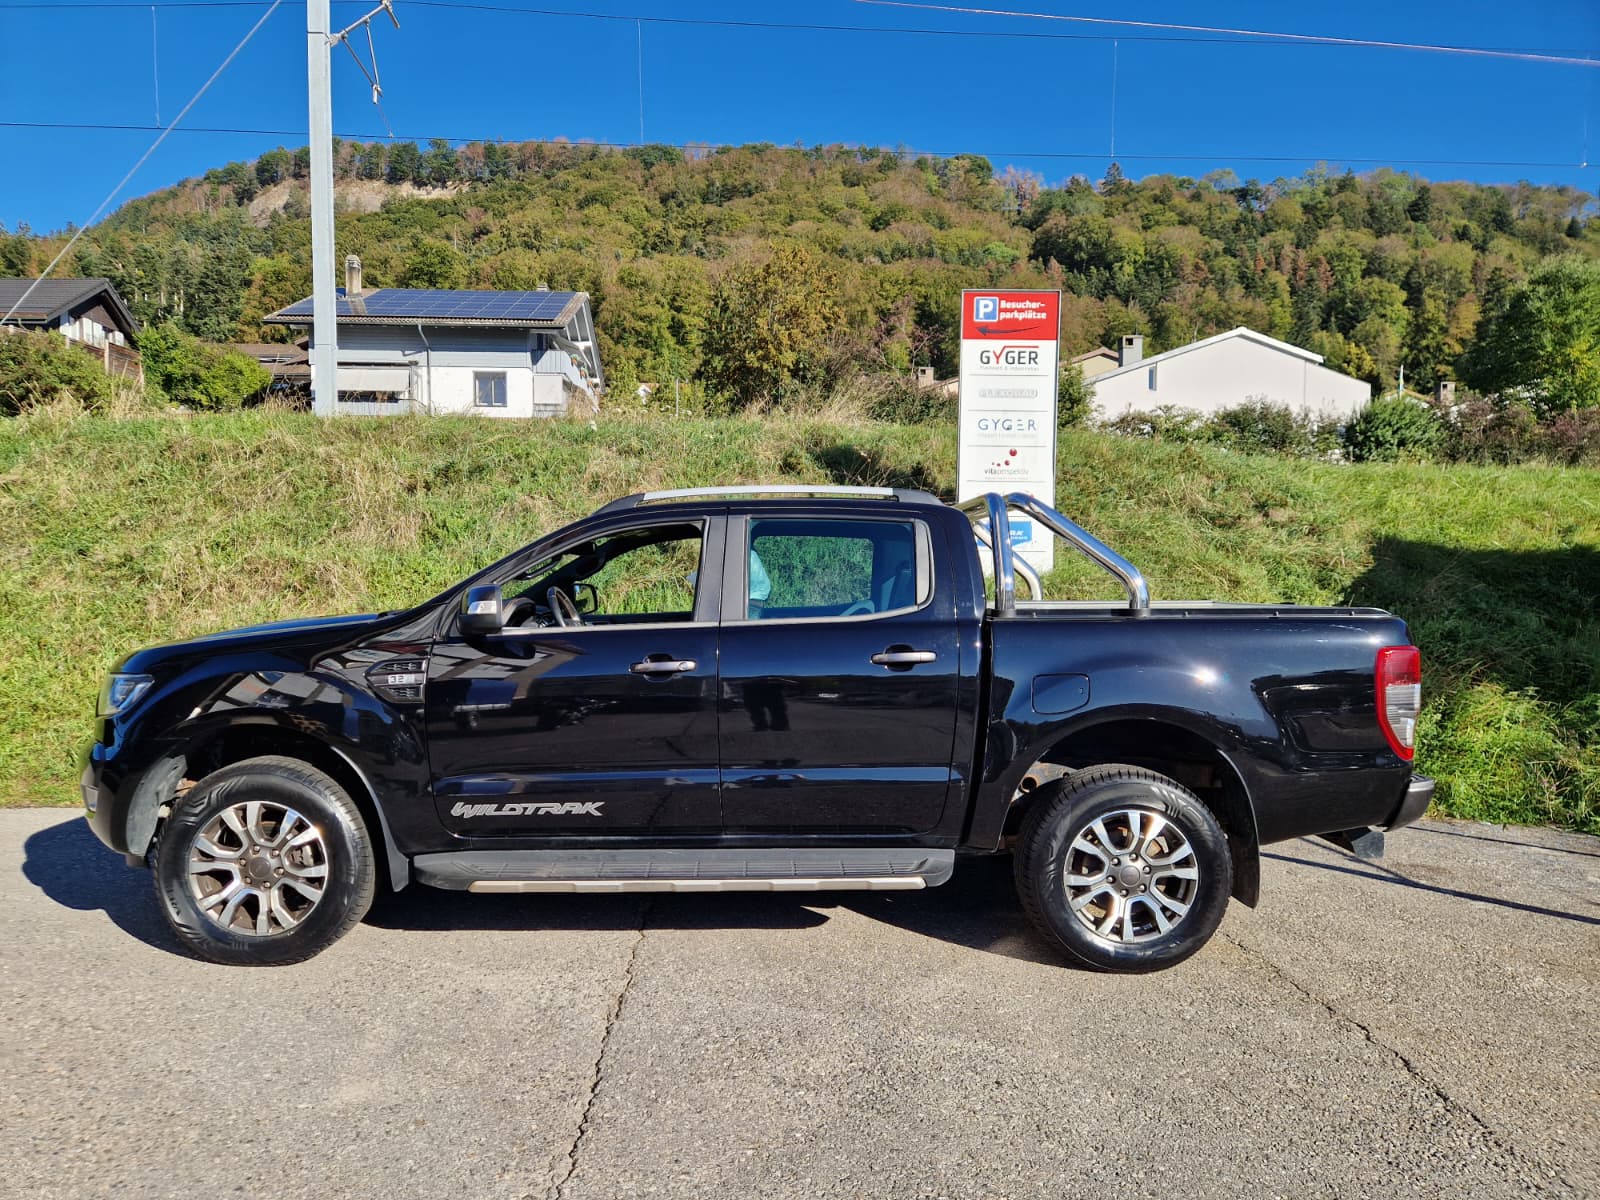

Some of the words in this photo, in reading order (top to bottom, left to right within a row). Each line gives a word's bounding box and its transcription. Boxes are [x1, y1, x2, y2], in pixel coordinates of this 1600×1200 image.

[978, 299, 994, 319] P
[1000, 299, 1046, 309] Besucher-
[1000, 310, 1047, 320] parkplätze
[980, 346, 1039, 365] GYGER
[977, 418, 1037, 431] GYGER
[450, 801, 605, 819] WILDTRAK
